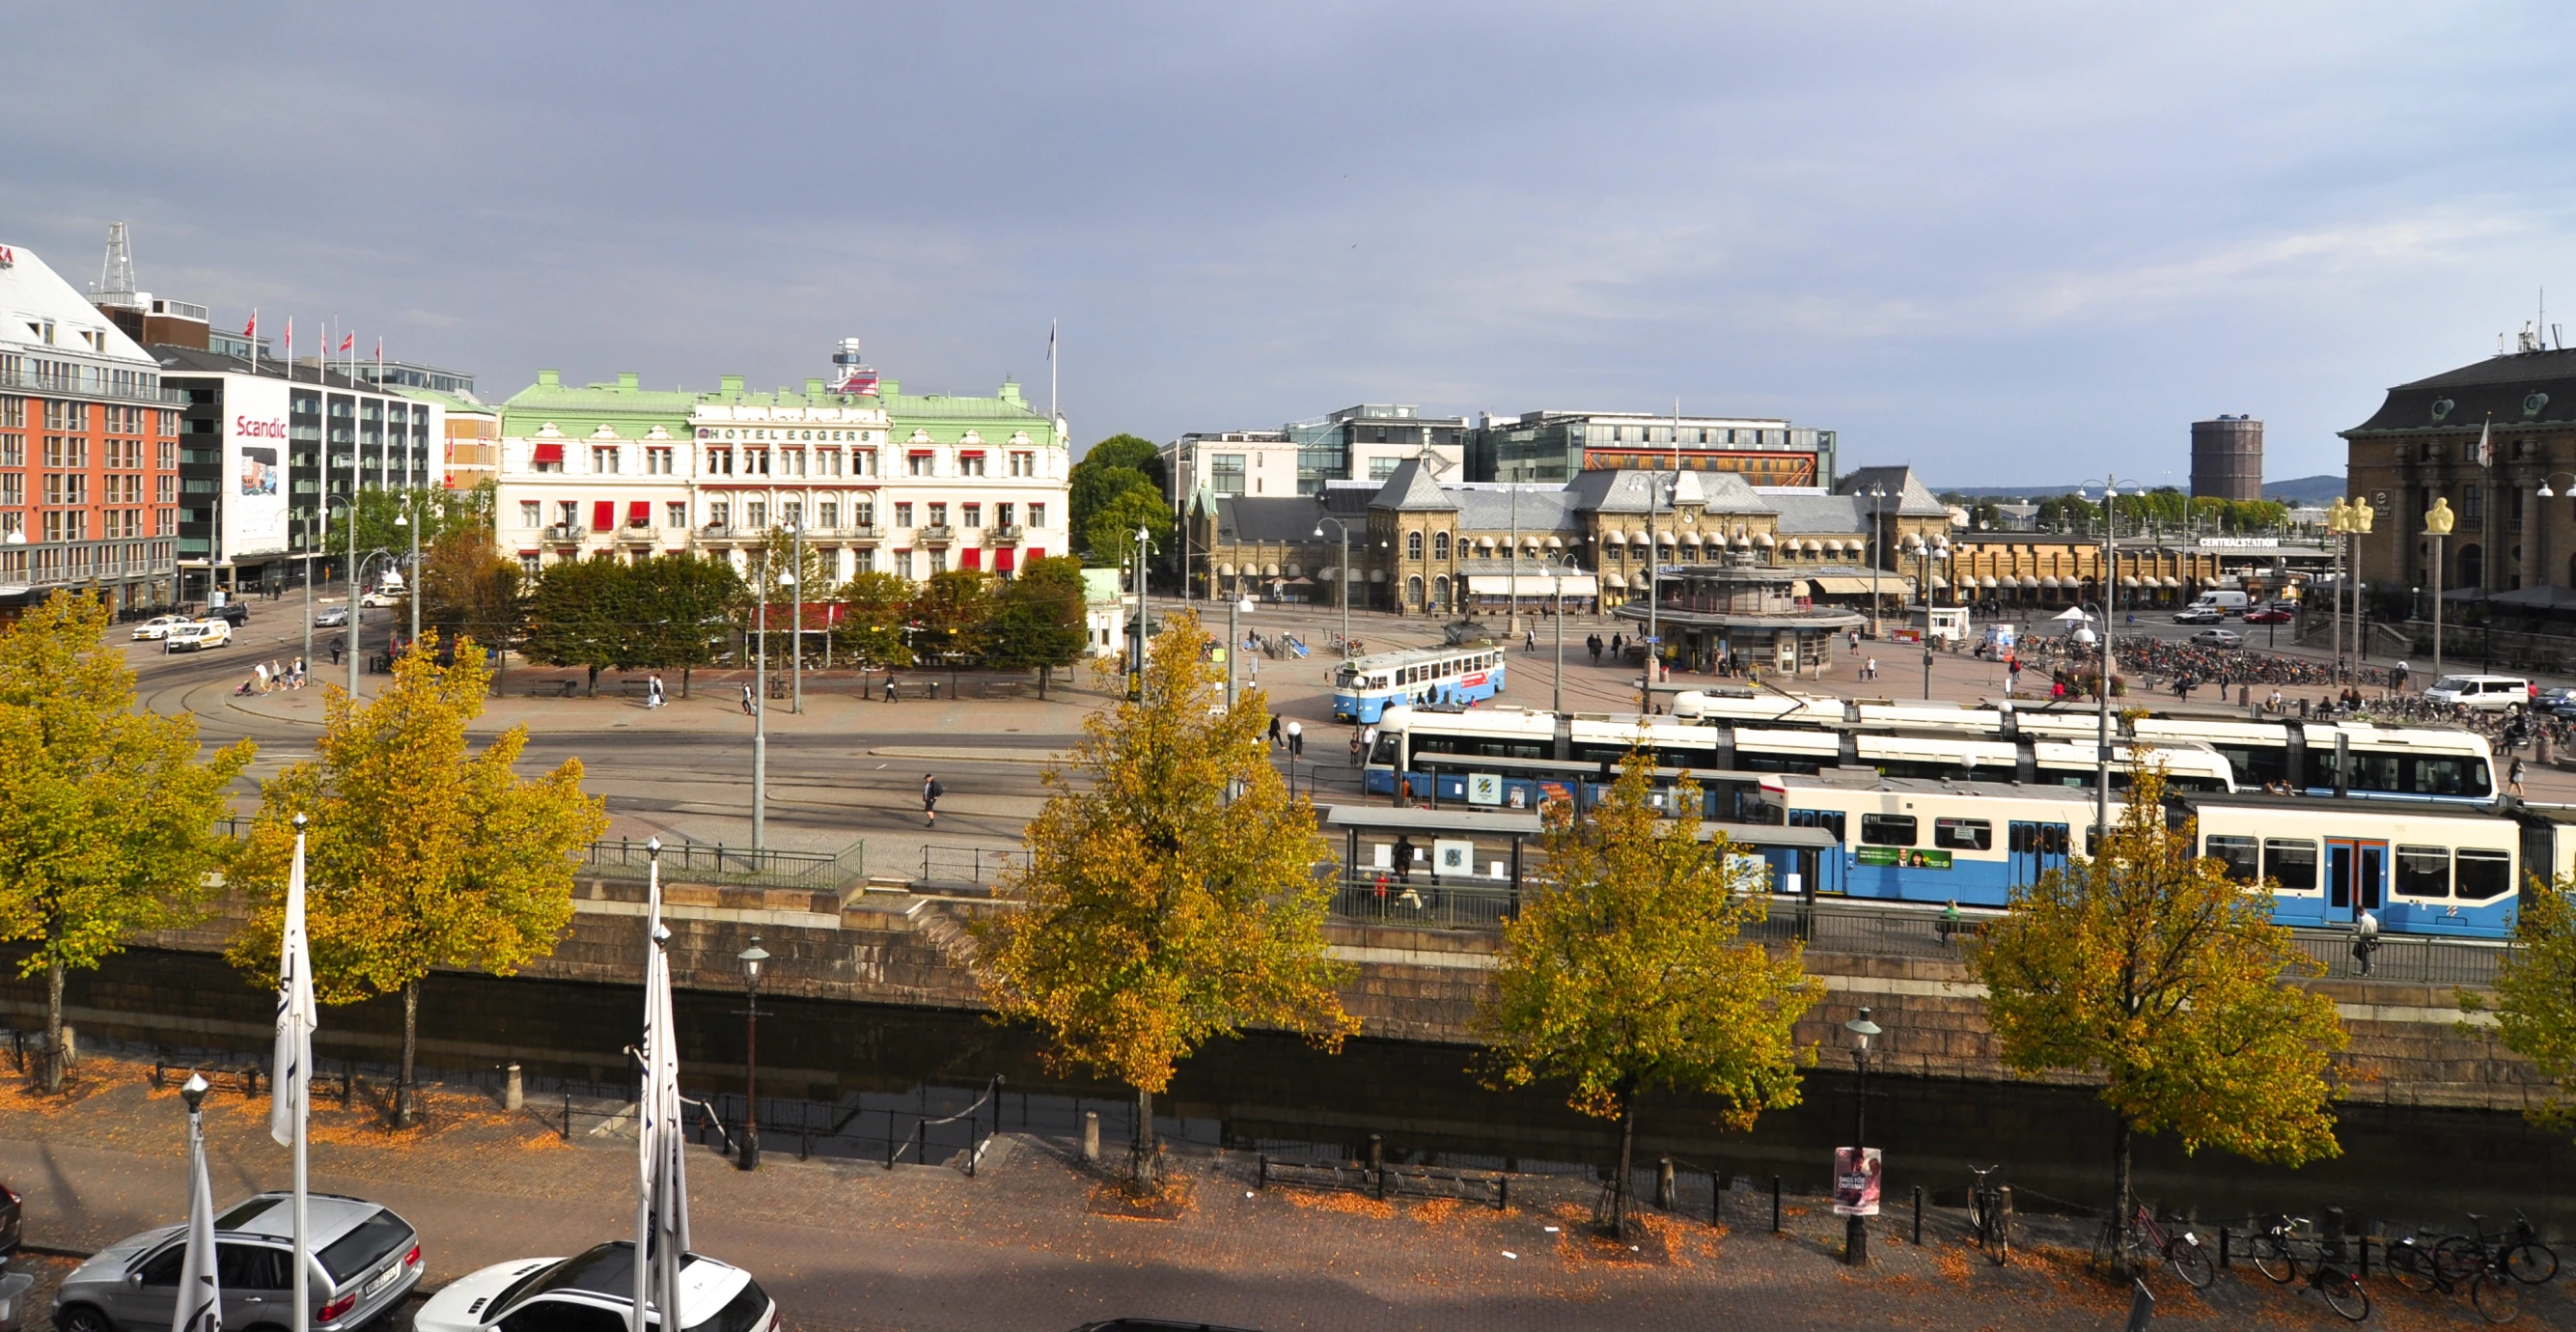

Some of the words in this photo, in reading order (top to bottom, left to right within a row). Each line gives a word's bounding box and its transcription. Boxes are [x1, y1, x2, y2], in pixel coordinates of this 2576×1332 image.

[236, 415, 287, 438] Scandic
[710, 430, 778, 440] HOTEL
[787, 430, 871, 441] EGGERS
[2200, 538, 2279, 547] CENTRALSTATION
